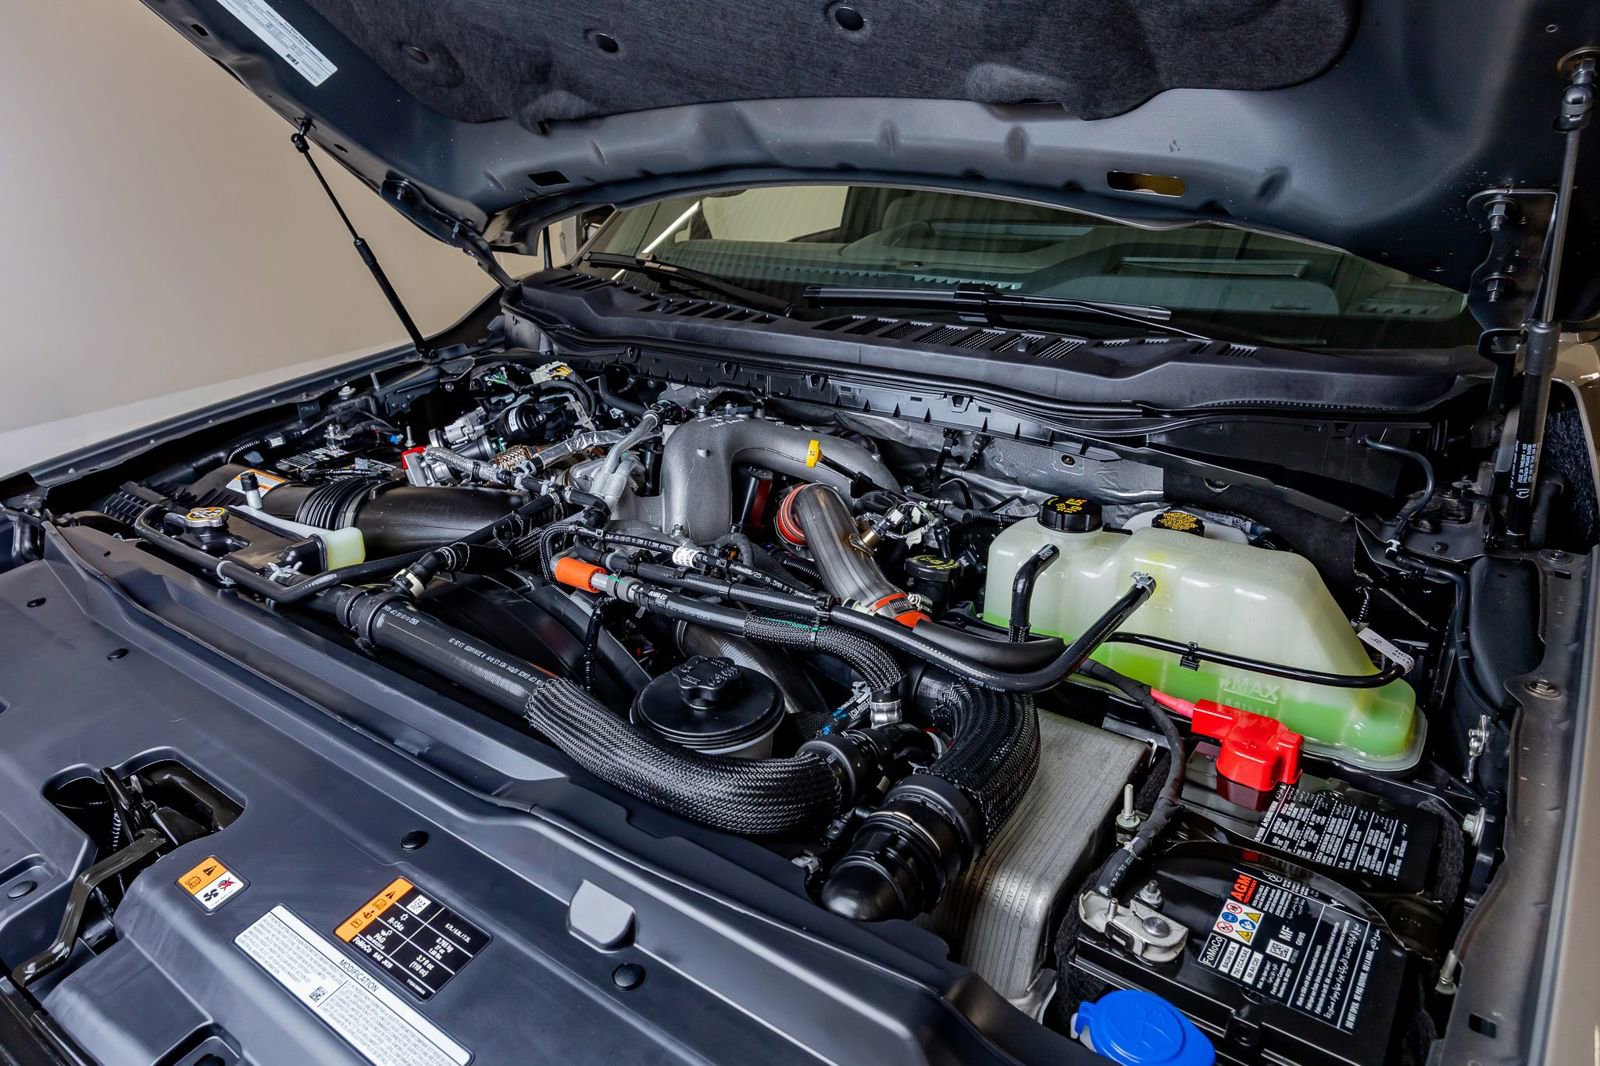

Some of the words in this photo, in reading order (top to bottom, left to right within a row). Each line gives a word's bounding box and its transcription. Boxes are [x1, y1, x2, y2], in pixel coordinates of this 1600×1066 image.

[1232, 875, 1251, 900] AGM
[388, 917, 404, 931] R-134a
[374, 933, 386, 943] PAG
[1279, 925, 1293, 941] MF
[353, 937, 372, 953] FoMoCo
[1204, 936, 1224, 965] FoMoCo
[339, 959, 378, 991] MODIFICATION
